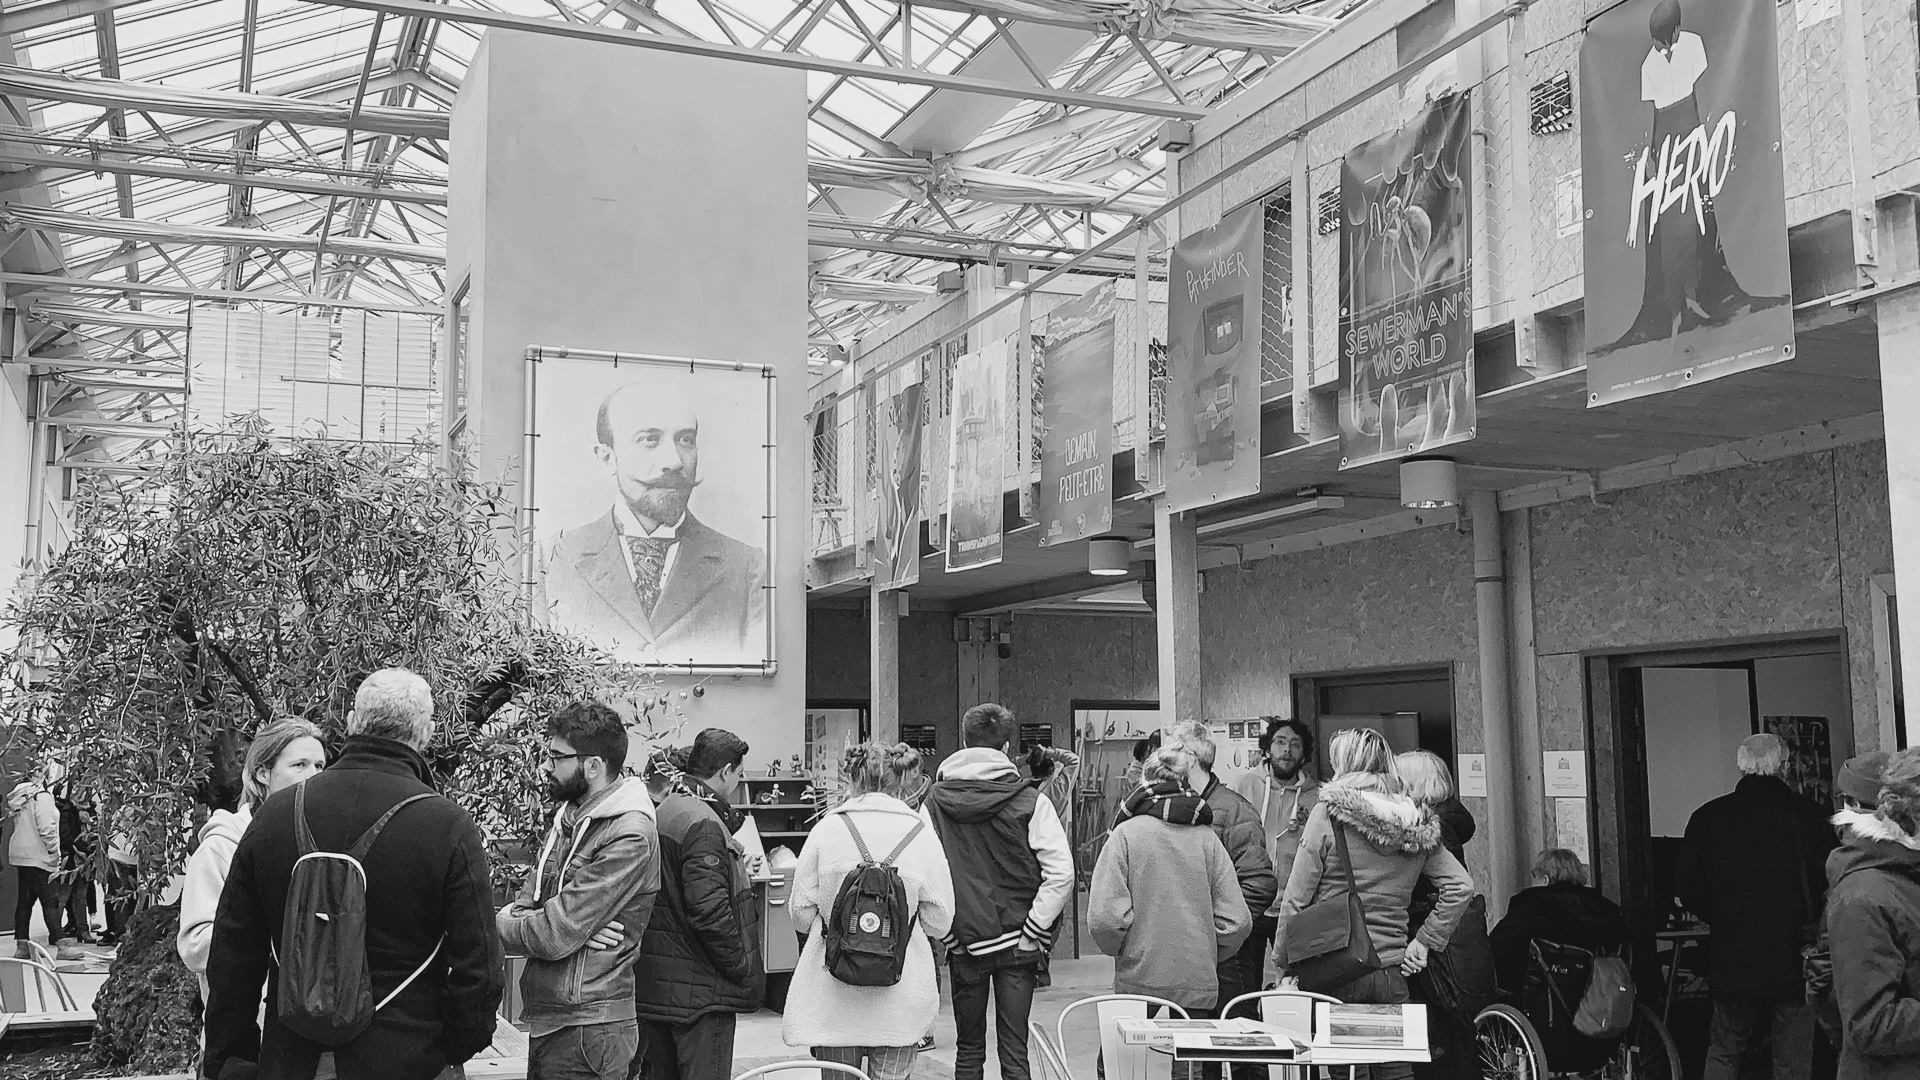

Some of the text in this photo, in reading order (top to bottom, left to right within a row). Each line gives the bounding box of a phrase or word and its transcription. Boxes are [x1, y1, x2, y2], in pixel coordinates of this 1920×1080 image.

[1626, 110, 1736, 248] HERO
[1344, 287, 1472, 358] SEWERMAN'S
[1372, 333, 1447, 380] WORLD
